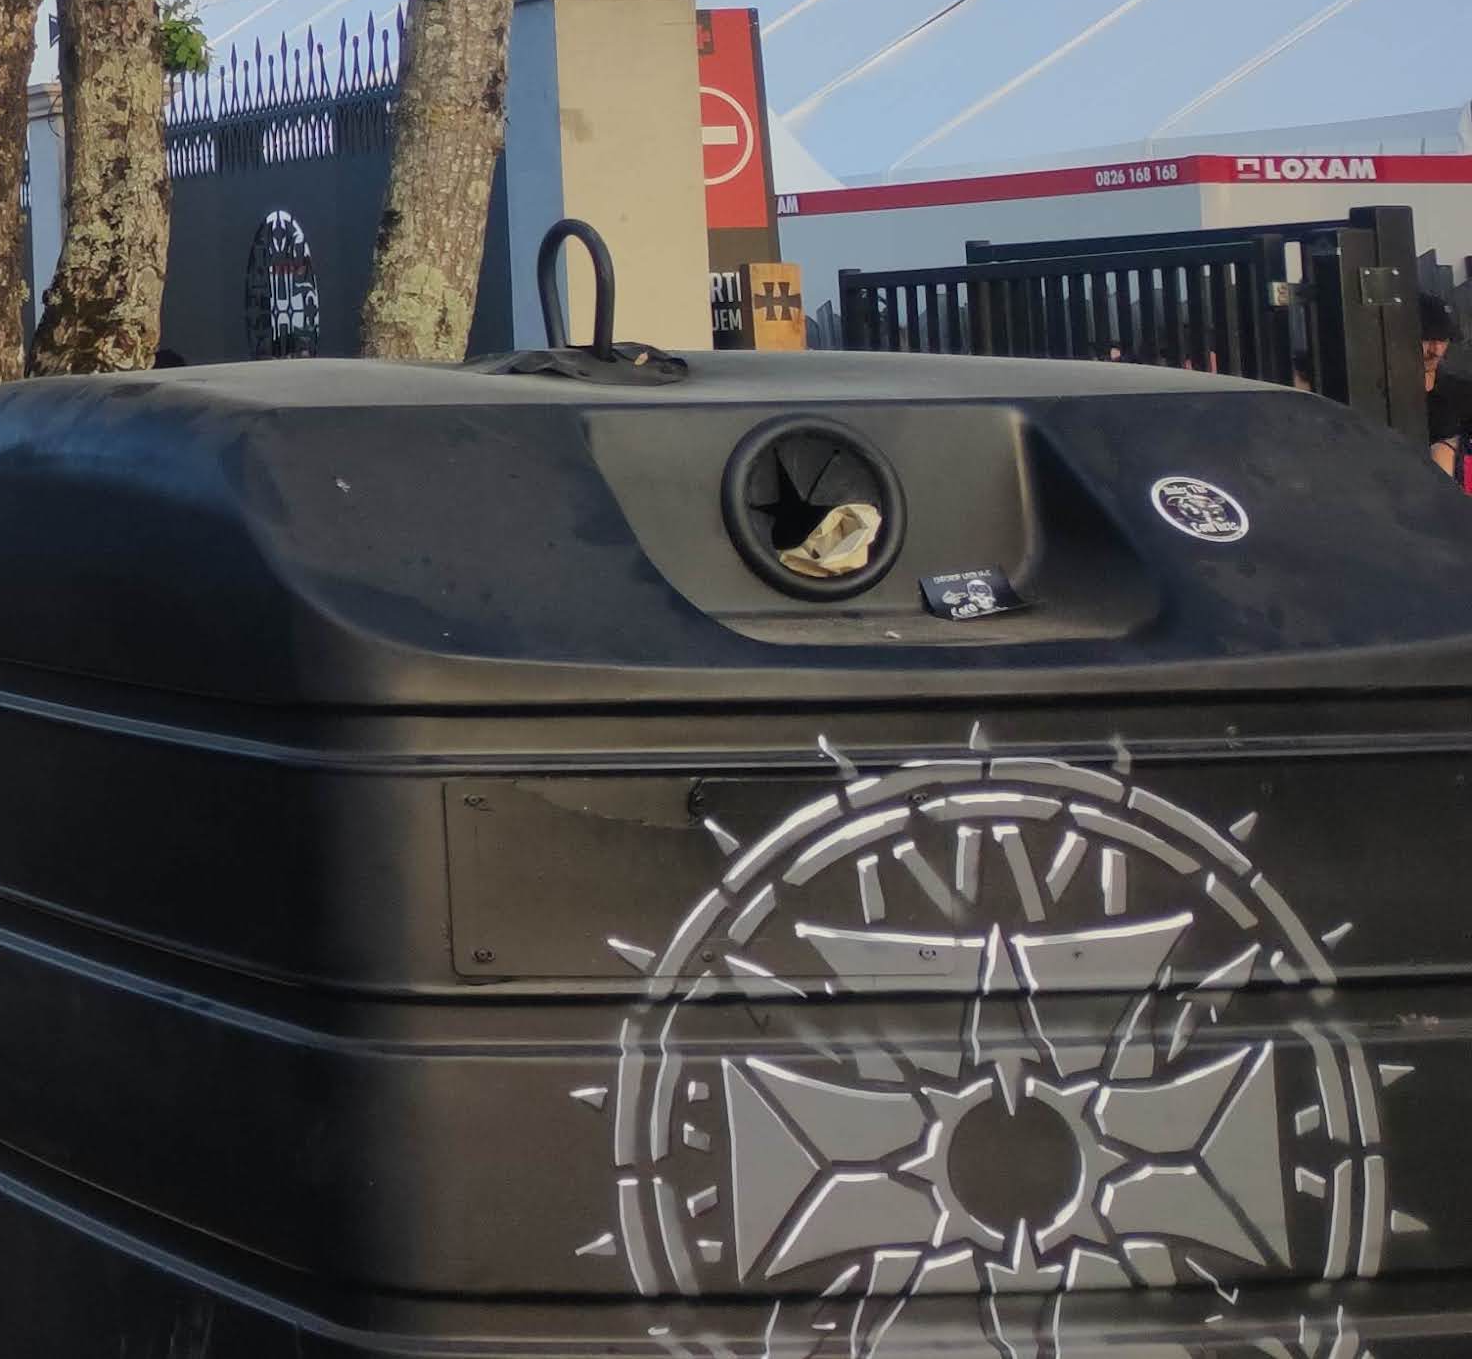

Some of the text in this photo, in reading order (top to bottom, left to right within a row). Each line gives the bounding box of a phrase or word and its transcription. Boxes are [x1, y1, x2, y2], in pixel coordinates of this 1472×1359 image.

[1095, 164, 1178, 187] 0826 168 168
[1265, 158, 1377, 181] LOXAM
